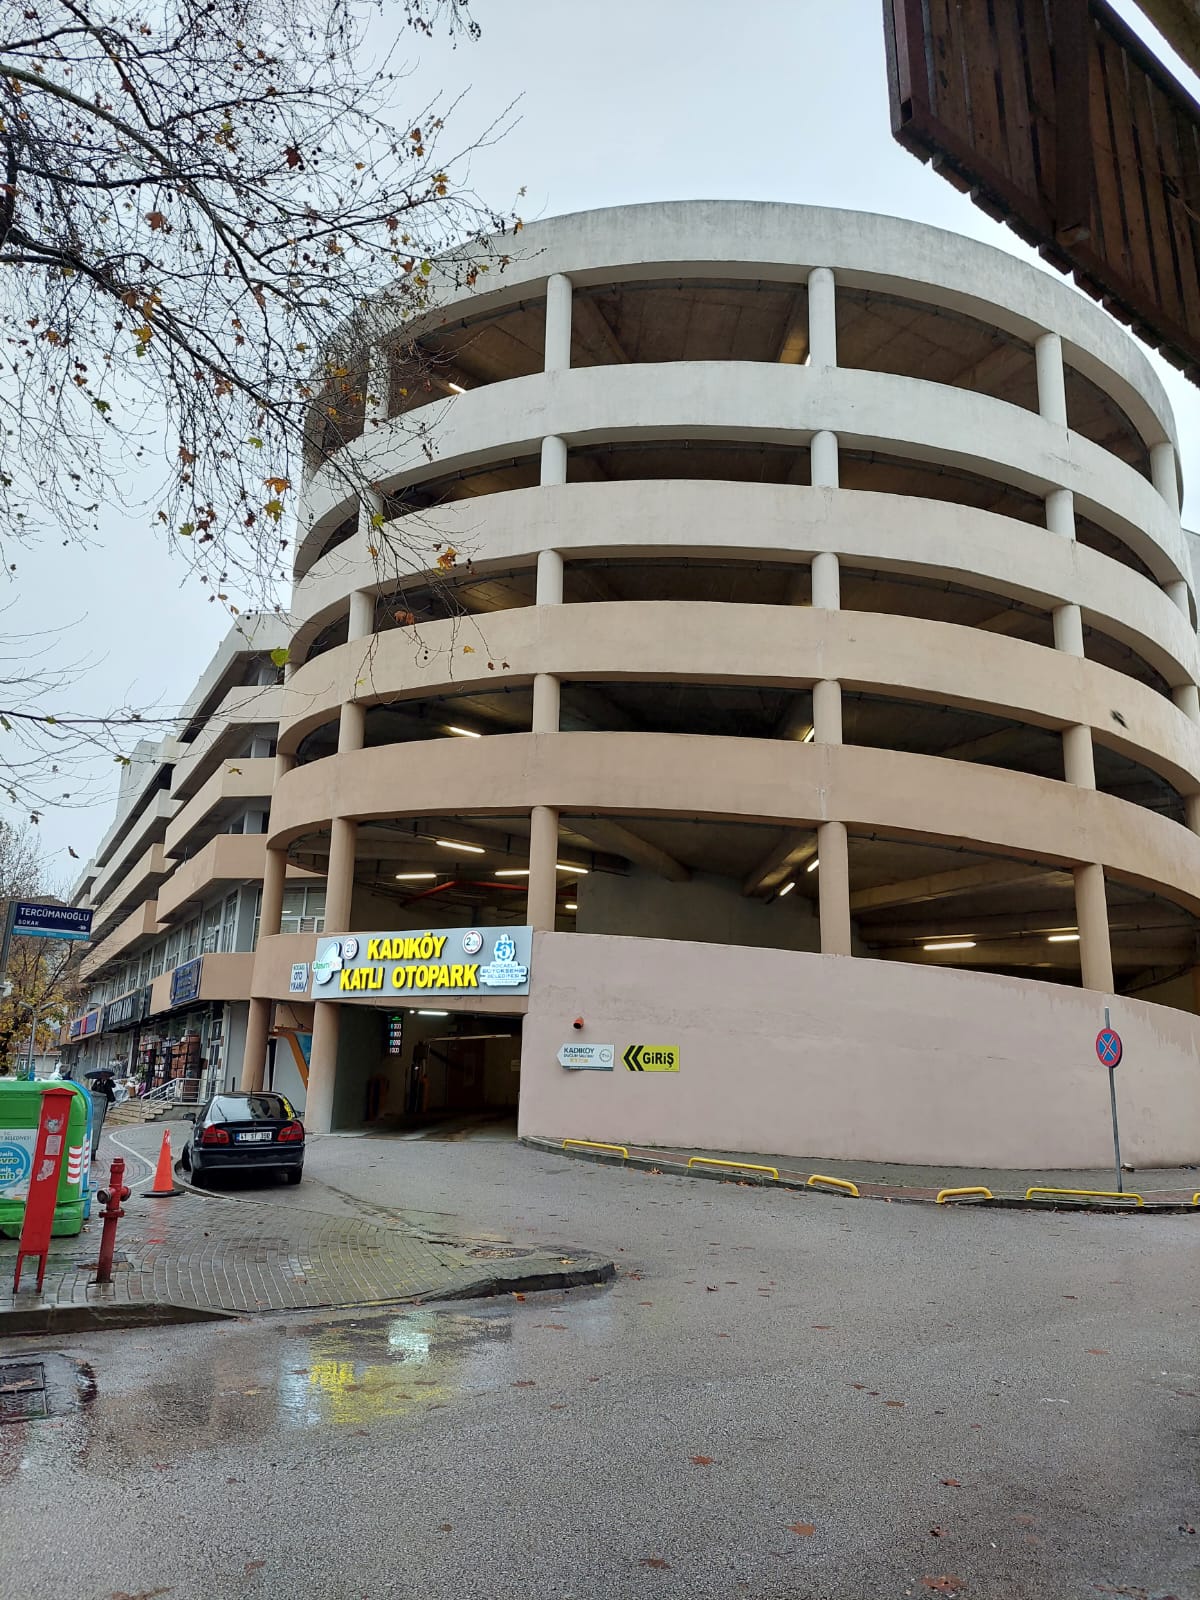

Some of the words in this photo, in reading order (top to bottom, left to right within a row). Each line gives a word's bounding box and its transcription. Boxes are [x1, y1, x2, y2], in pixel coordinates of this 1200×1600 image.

[20, 908, 90, 921] TERCÜMANOĞLU
[367, 933, 448, 960] KADIKÖY
[340, 967, 384, 991] KATLI
[392, 964, 480, 989] OTOPARK
